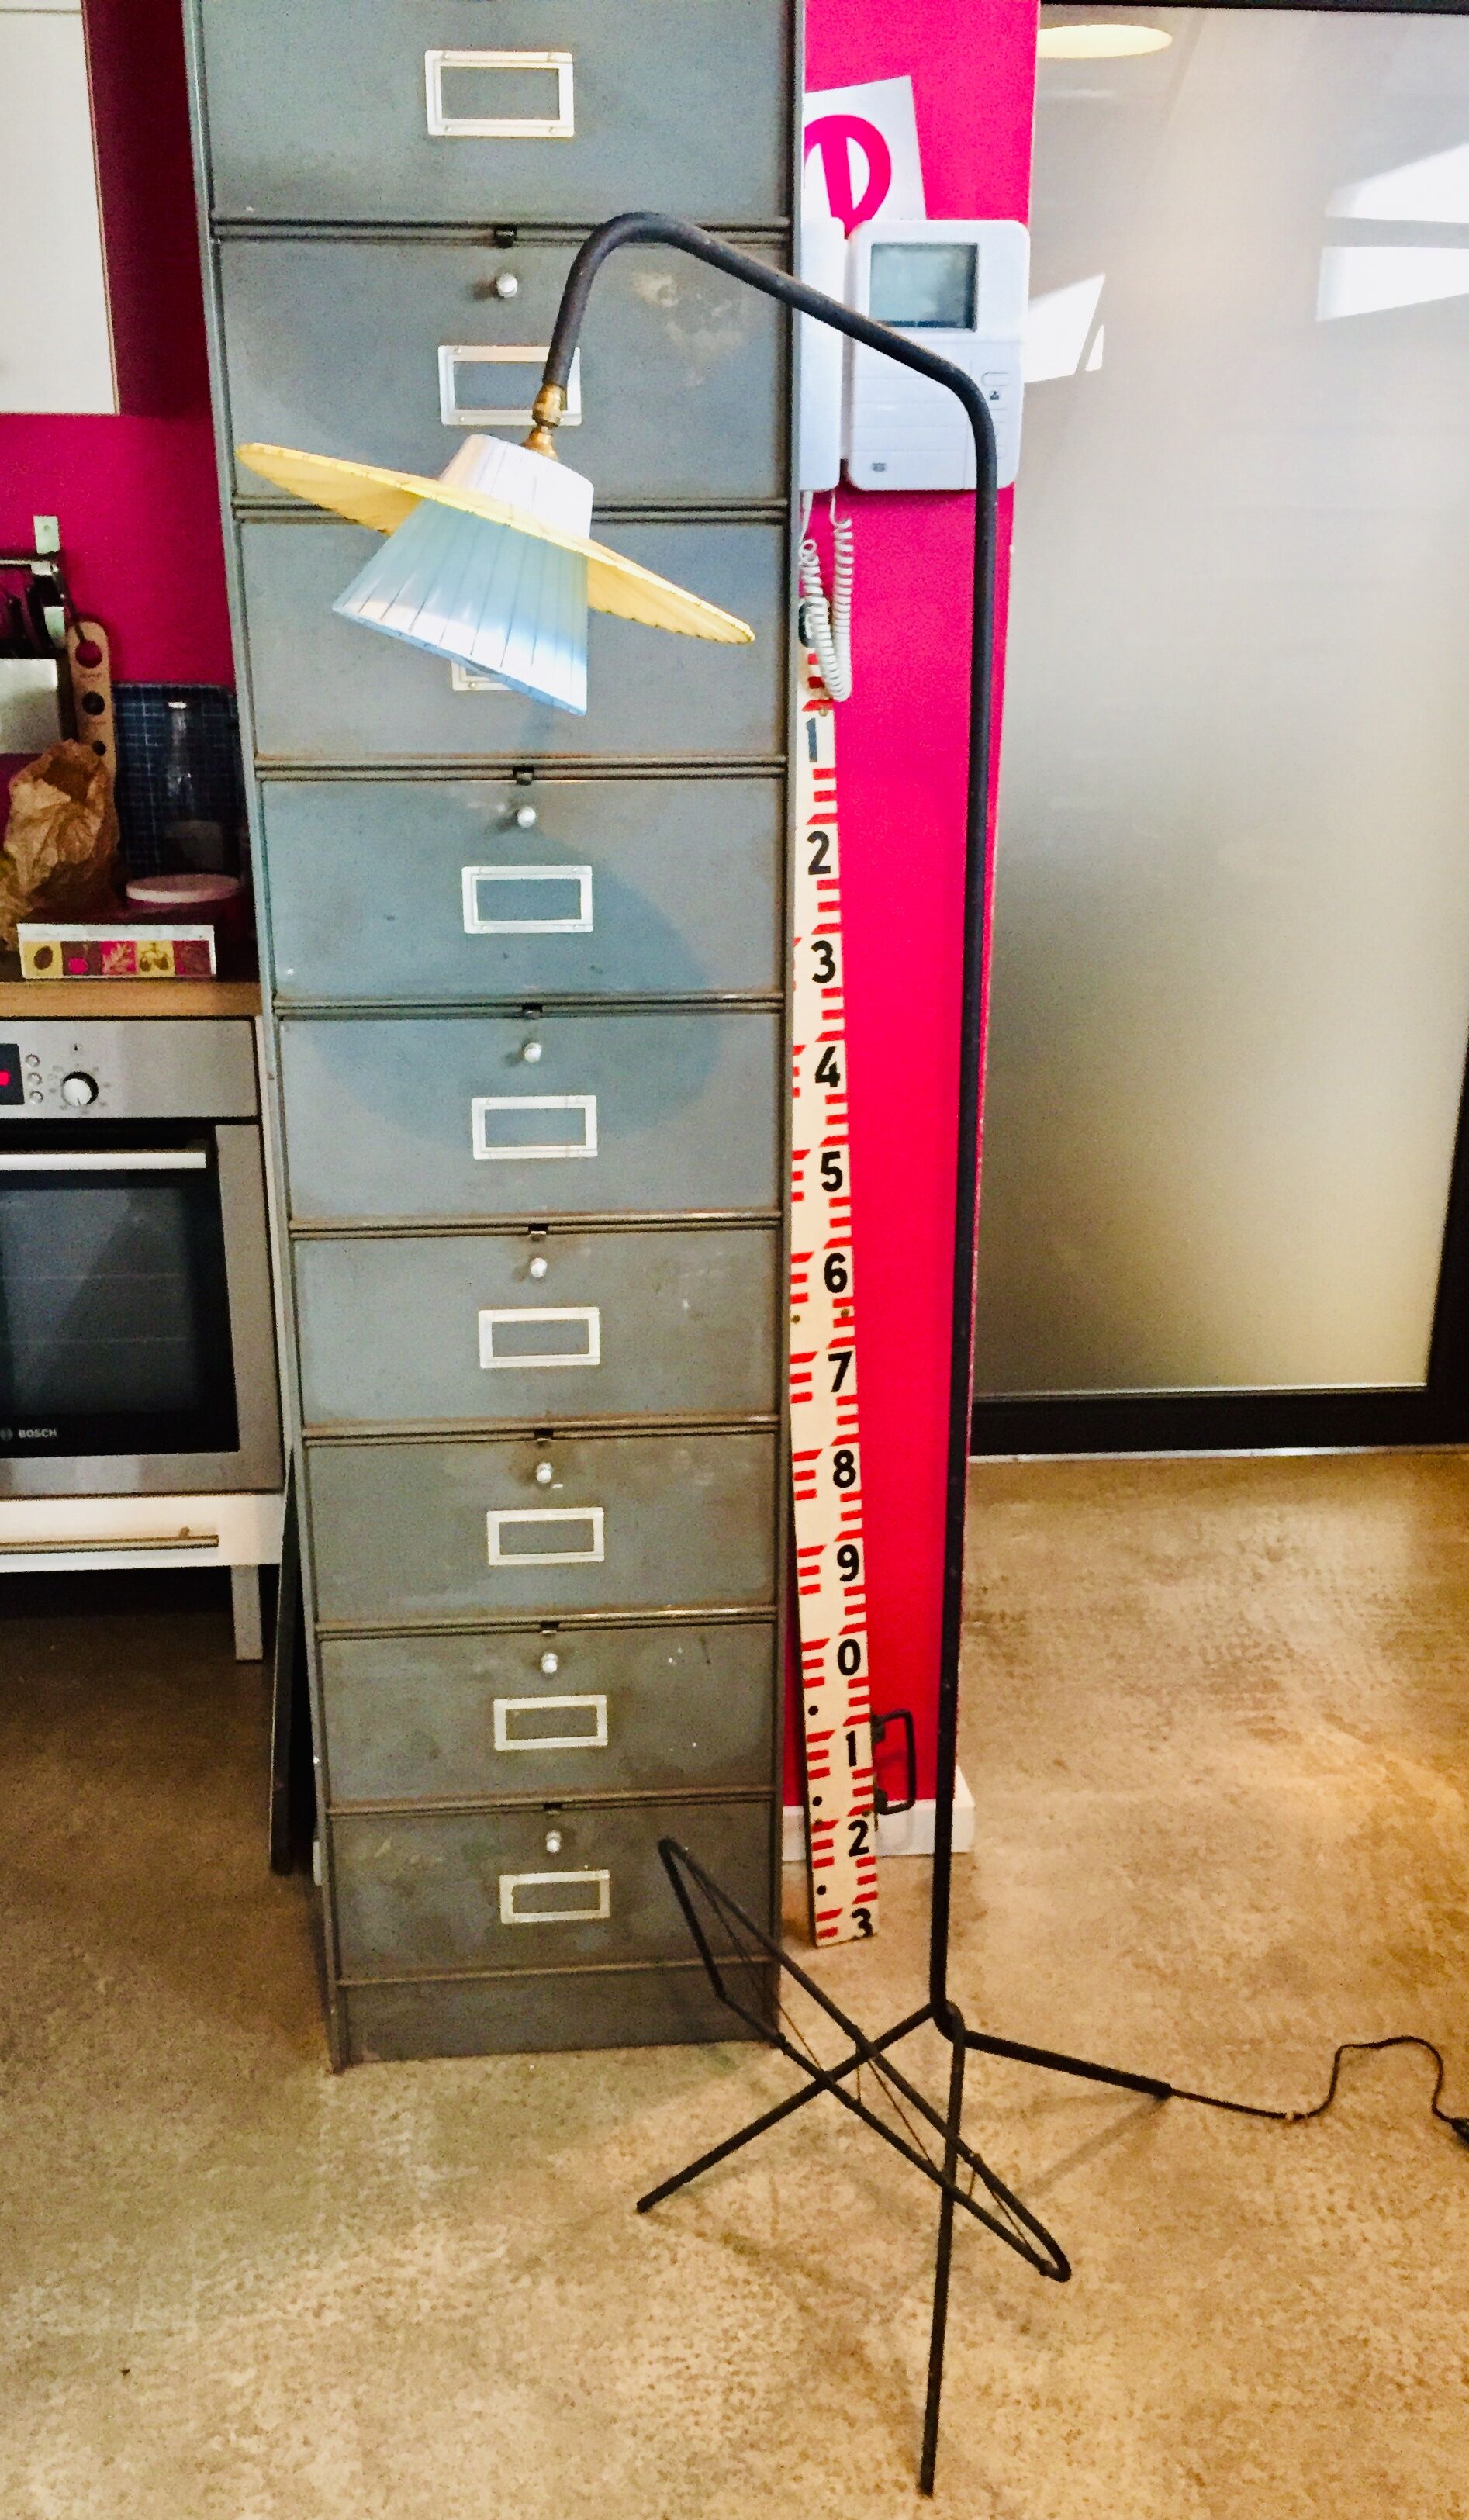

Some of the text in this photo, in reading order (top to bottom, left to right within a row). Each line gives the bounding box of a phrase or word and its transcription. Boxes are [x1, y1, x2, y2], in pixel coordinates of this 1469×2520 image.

[806, 717, 818, 763] 1
[807, 831, 831, 876] 2
[811, 940, 836, 983] 3
[814, 1046, 841, 1088] 4
[821, 1150, 843, 1192] 5
[824, 1252, 848, 1294] 6
[828, 1350, 853, 1393] 7
[19, 1429, 57, 1438] BOSCH
[832, 1449, 856, 1488] 8
[837, 1544, 860, 1582] 9
[837, 1638, 862, 1676] 0
[845, 1730, 857, 1768] 1
[848, 1820, 870, 1858] 2
[852, 1908, 873, 1937] 3
